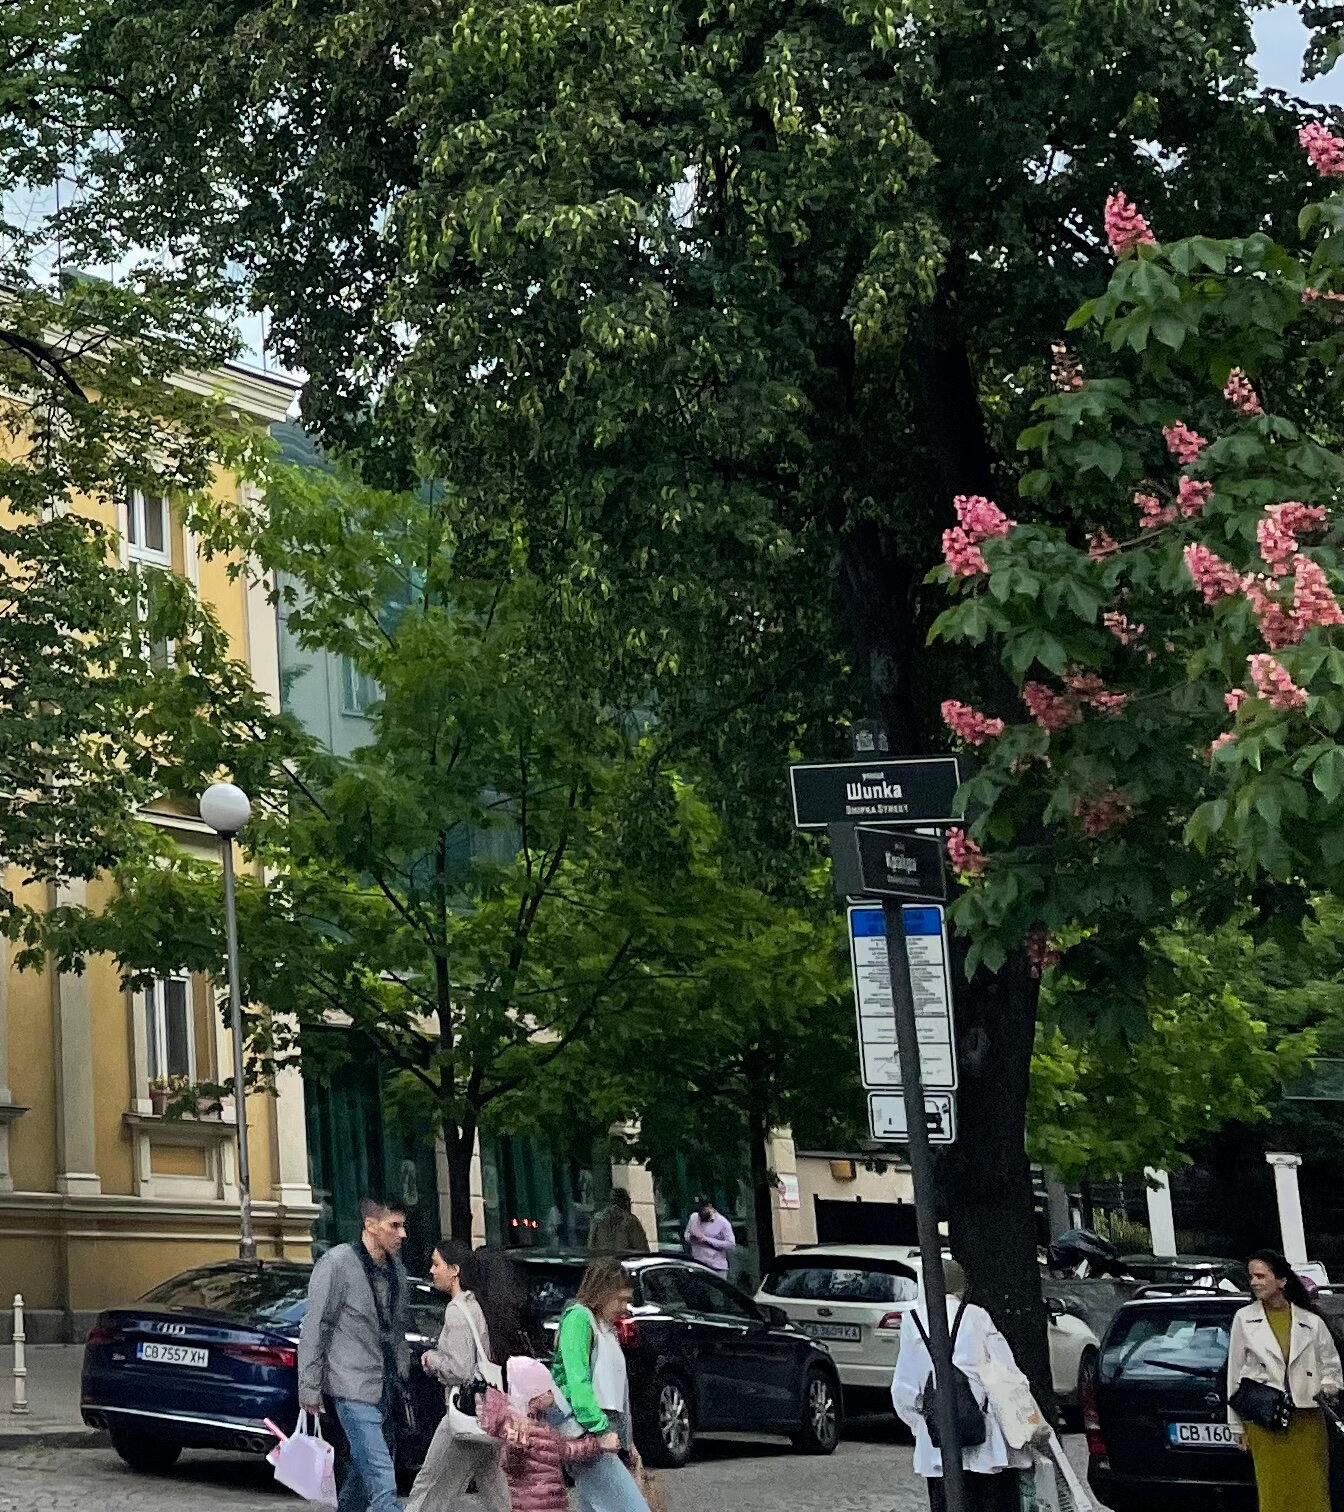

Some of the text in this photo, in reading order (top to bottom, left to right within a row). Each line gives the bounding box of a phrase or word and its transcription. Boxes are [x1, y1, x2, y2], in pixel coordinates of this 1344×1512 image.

[144, 1345, 206, 1364] CB 7557 XH
[1179, 1425, 1200, 1441] CB
